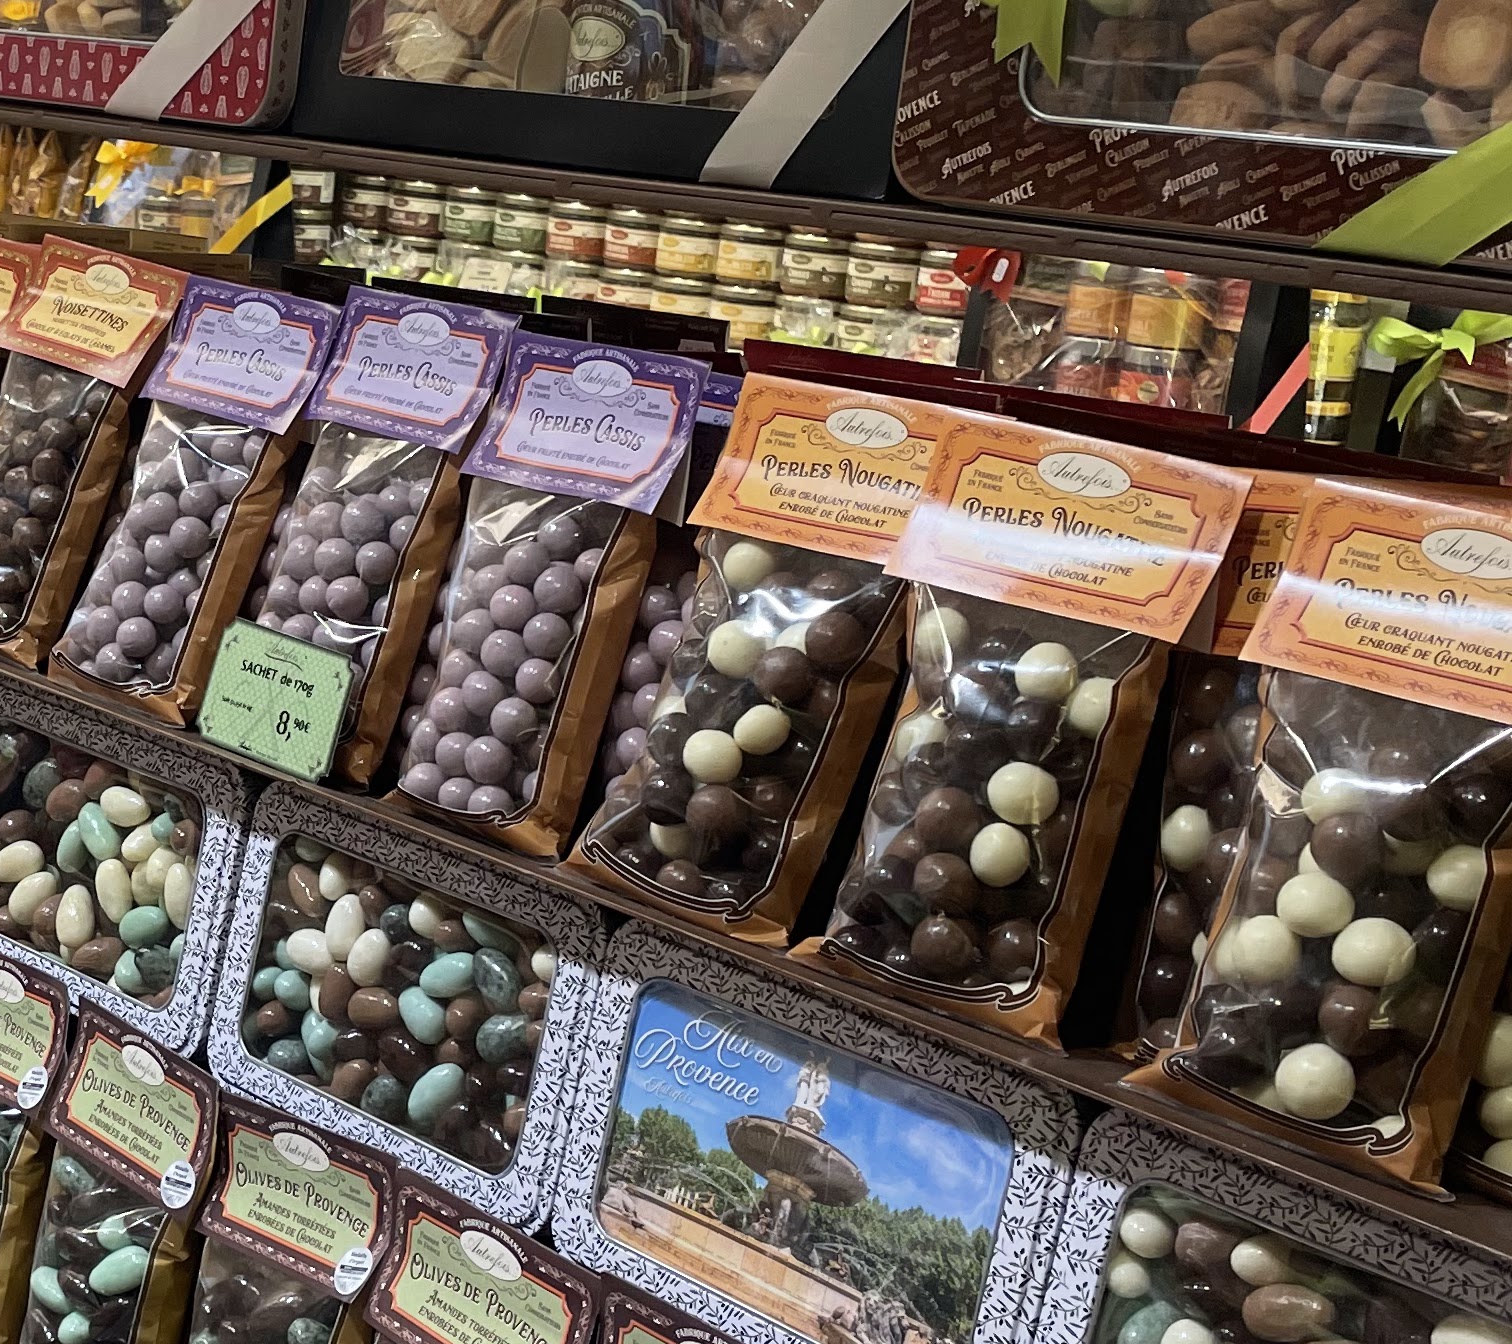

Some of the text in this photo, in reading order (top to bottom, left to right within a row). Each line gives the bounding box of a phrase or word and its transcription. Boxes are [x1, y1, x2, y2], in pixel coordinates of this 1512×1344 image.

[941, 141, 992, 179] AUTREFOIS
[1349, 160, 1401, 191] CALISSON
[1161, 162, 1219, 202] AUTREFOIS
[53, 295, 129, 333] NOISETTINES
[195, 341, 287, 382] PERLES CASSIS
[358, 356, 457, 397] PERLES CASSIS
[529, 407, 646, 452] PERLES CASSIS
[1038, 440, 1085, 454] FABRIQUE
[761, 454, 833, 482] PERLES
[798, 491, 911, 519] CRAQUANT NOUGATINE
[820, 508, 834, 519] DE
[835, 508, 888, 529] CHOCOLAT
[962, 497, 1045, 529] PERLES
[1422, 515, 1478, 530] FABRIQUE
[1048, 562, 1108, 587] CHOCOLAT
[1350, 558, 1381, 573] FRANCE
[1335, 577, 1429, 612] PERLES
[1358, 635, 1504, 677] ENROBÉ DE CHOCOLAT
[1383, 625, 1455, 650] CRAQUANT
[240, 659, 315, 698] SACHET de 170g
[4, 1013, 47, 1058] PROVENCE
[683, 1011, 784, 1075] Aix en
[634, 1027, 761, 1107] Provence
[82, 1068, 191, 1153] OLIVES DE PROVENCE
[235, 1162, 370, 1239] OLIVES DE PROVENCE
[409, 1252, 462, 1293] OLIVES
[463, 1282, 482, 1304] DE
[424, 1289, 468, 1323] AMANDES
